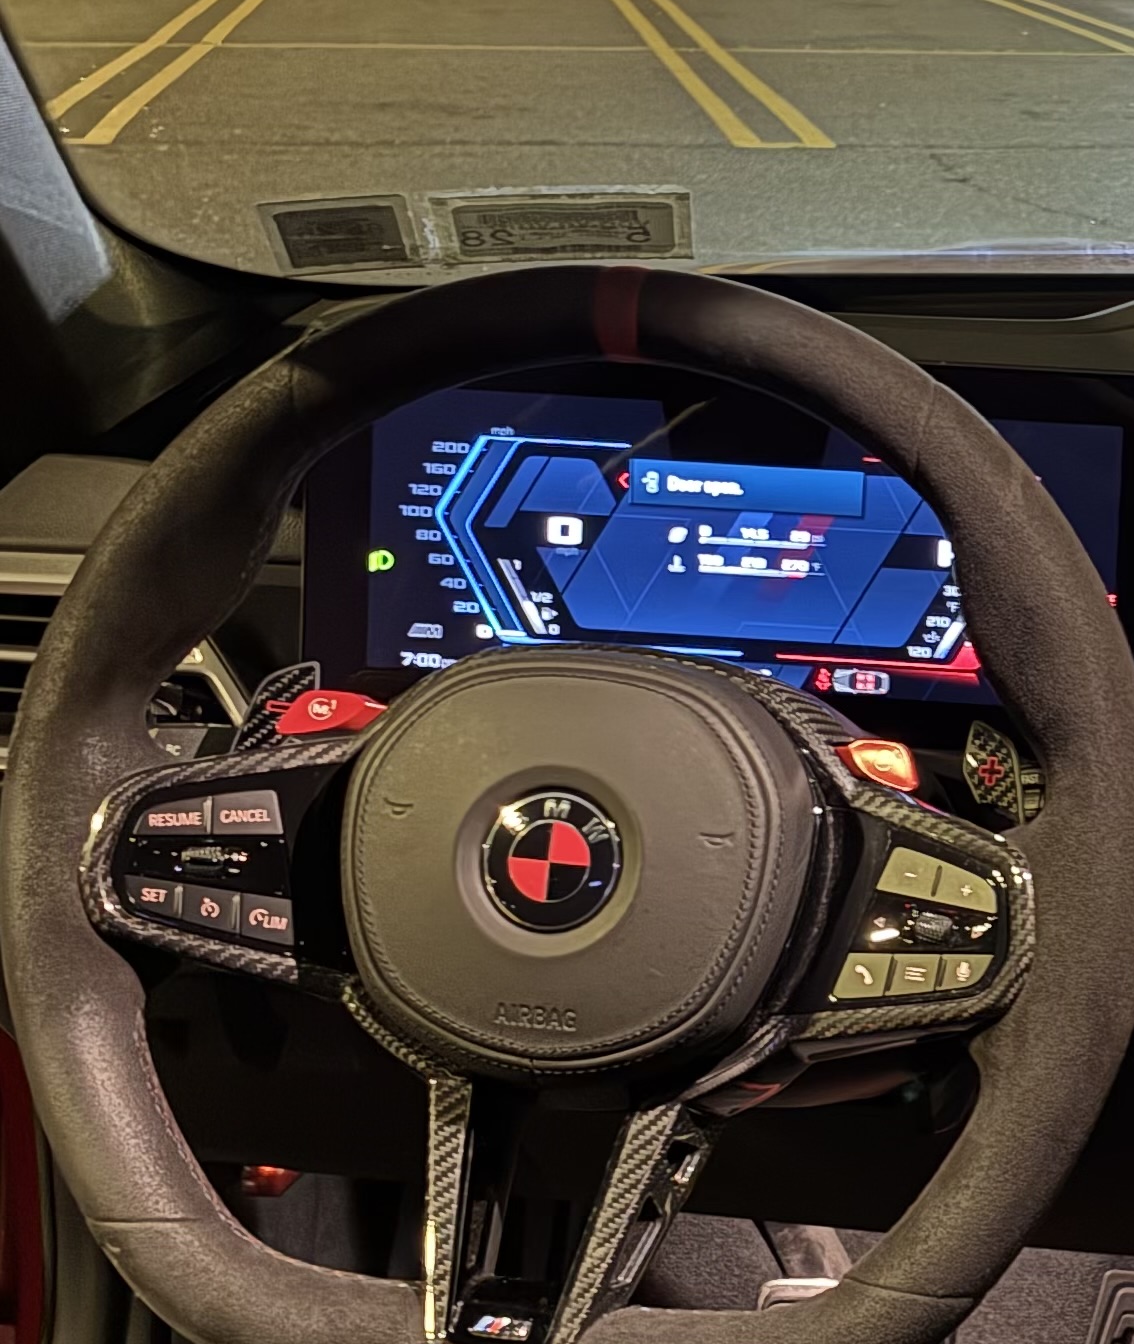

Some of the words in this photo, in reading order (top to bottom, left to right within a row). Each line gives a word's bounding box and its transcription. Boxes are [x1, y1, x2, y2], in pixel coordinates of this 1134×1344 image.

[431, 440, 471, 454] 200
[422, 462, 457, 475] 160
[408, 483, 443, 496] 120
[398, 504, 433, 517] 100
[415, 528, 442, 542] 80
[546, 515, 584, 545] 0
[427, 552, 455, 566] 60
[439, 577, 467, 591] 40
[452, 600, 480, 614] 20
[925, 616, 951, 628] 210
[906, 645, 933, 659] 120
[148, 811, 202, 827] RESUME
[219, 808, 271, 823] CANCEL
[502, 798, 611, 844] MW
[140, 887, 168, 903] SET
[263, 915, 288, 930] LIM
[494, 1002, 577, 1032] AIRBAG
